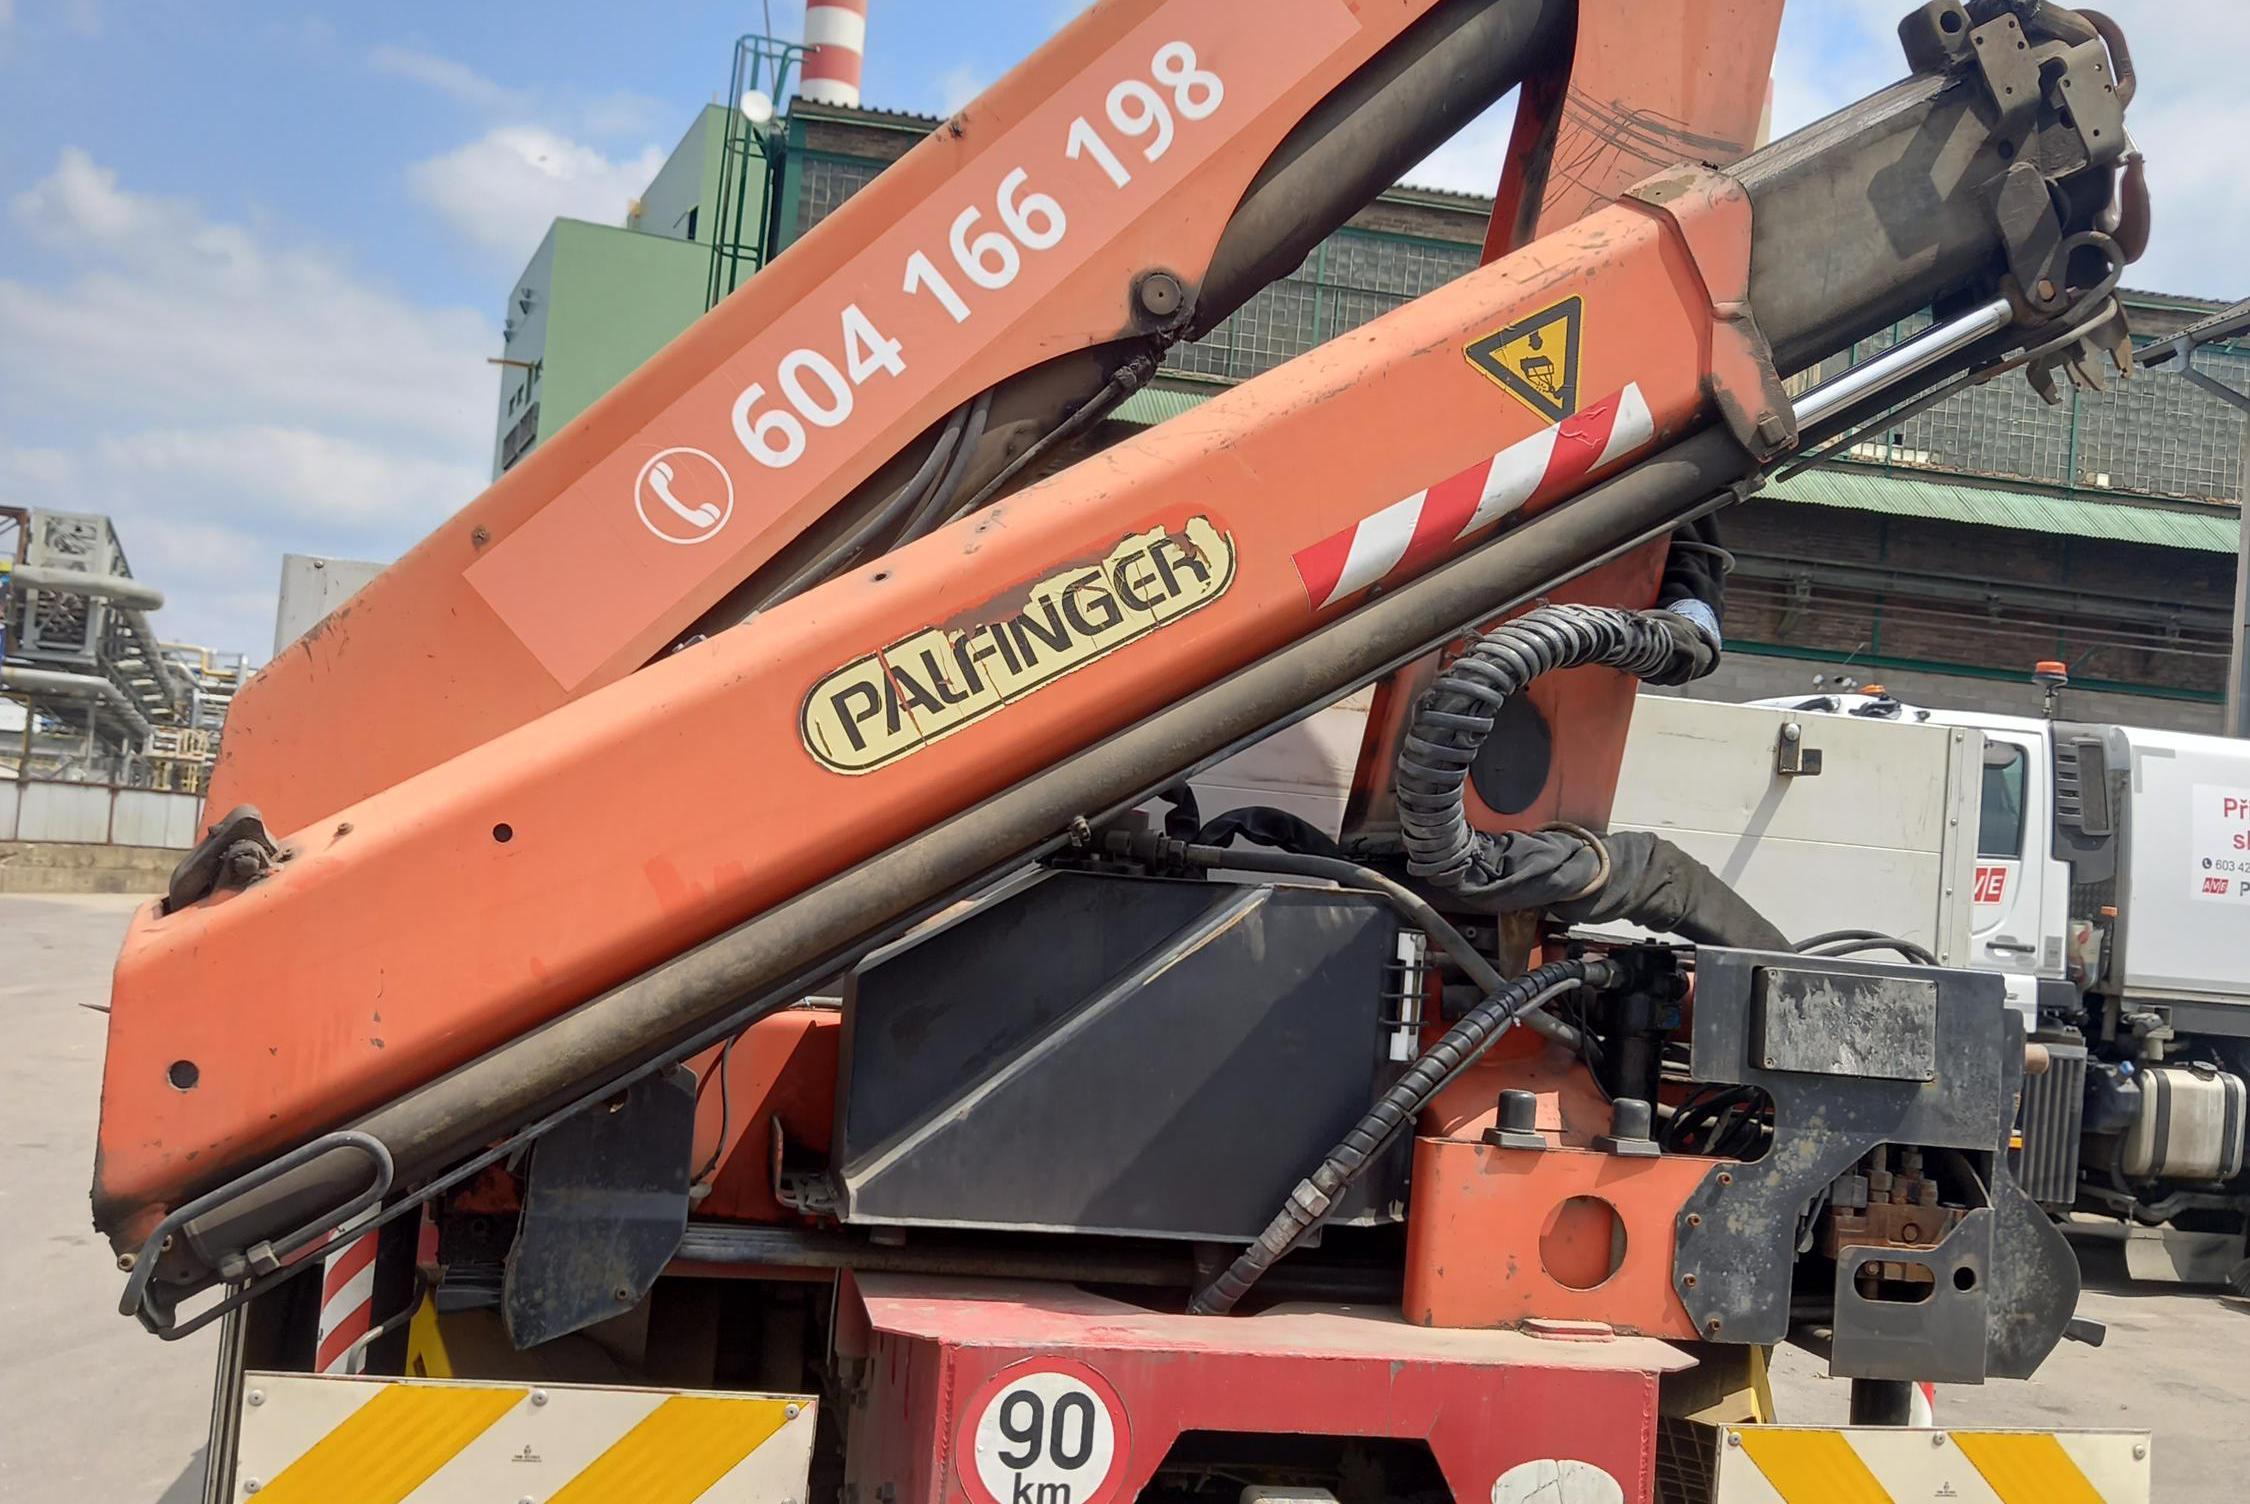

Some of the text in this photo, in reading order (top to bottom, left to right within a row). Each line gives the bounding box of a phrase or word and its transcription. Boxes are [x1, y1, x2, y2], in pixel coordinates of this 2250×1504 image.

[731, 41, 1224, 468] 604 166 198
[831, 537, 1212, 752] PALFINGER
[2223, 797, 2250, 820] Př
[2232, 830, 2250, 850] s
[2215, 859, 2235, 872] 603
[998, 1389, 1096, 1470] 90
[1011, 1472, 1071, 1504] km
